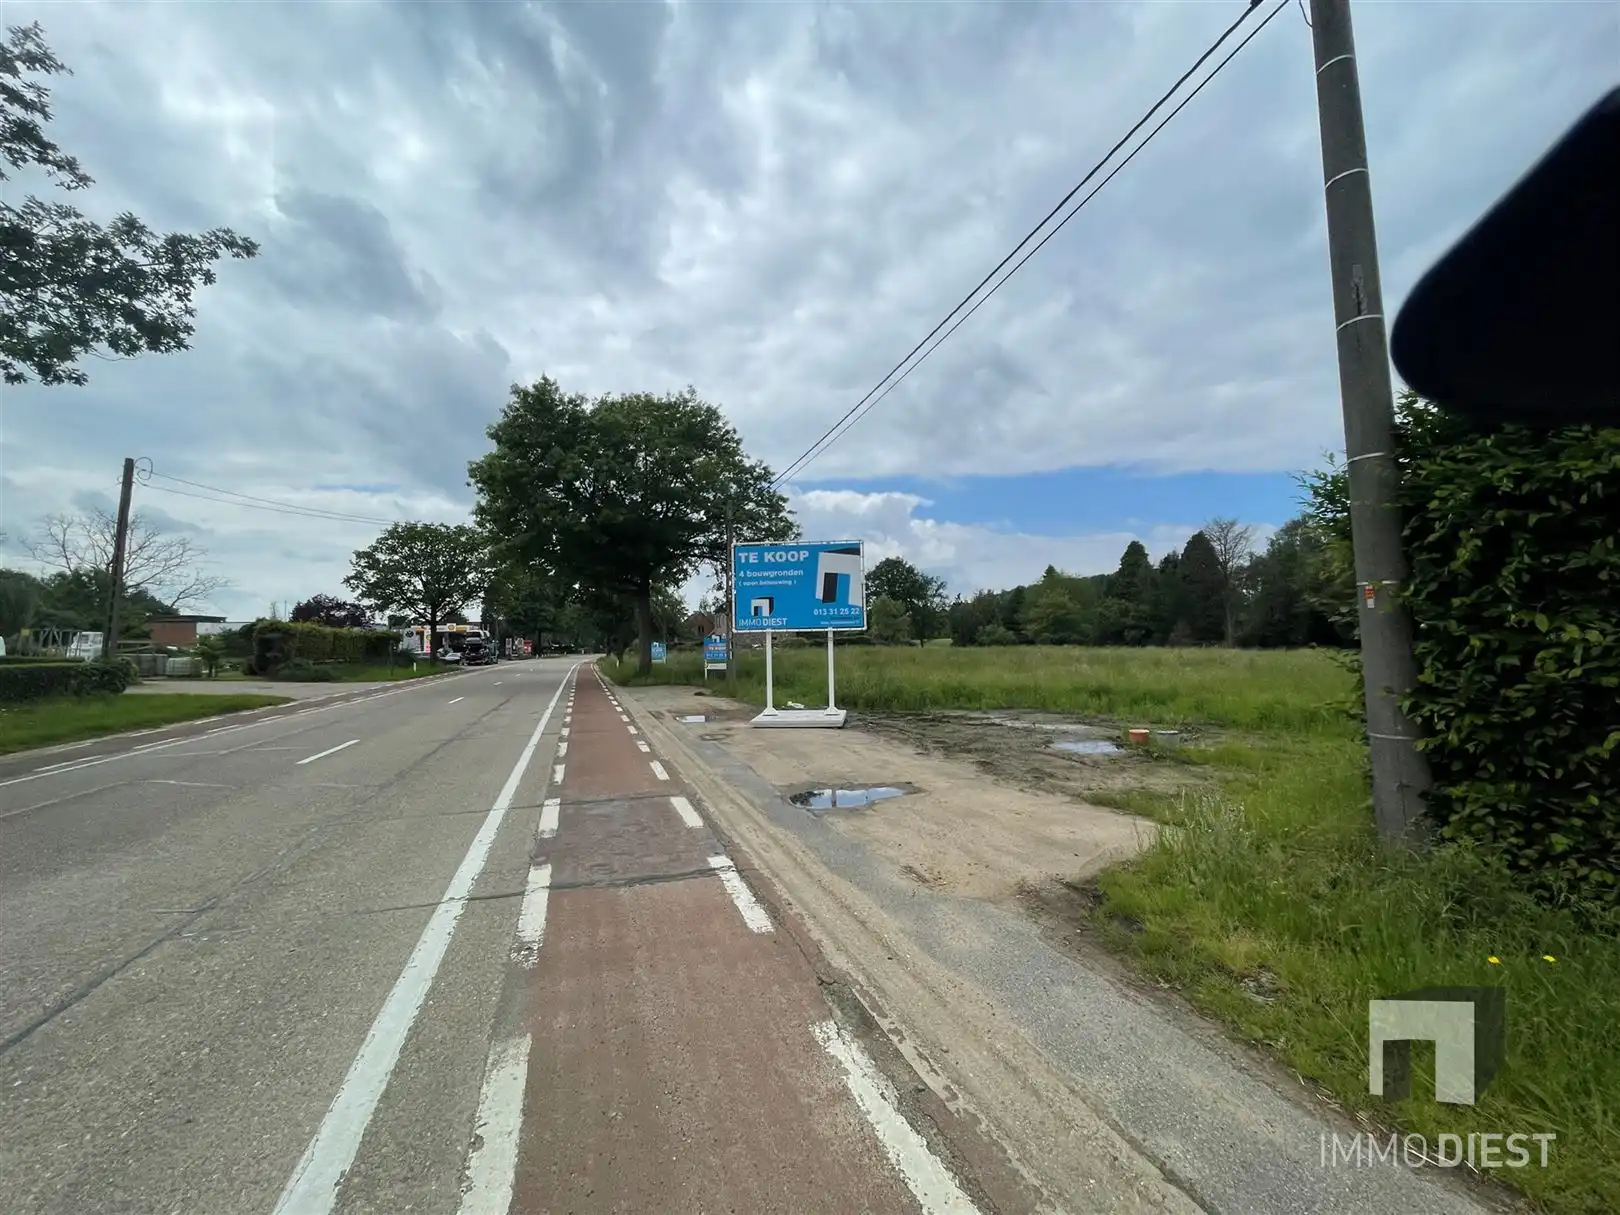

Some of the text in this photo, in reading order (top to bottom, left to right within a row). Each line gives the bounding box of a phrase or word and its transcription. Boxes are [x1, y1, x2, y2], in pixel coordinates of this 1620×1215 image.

[738, 551, 809, 563] TE KOOP
[747, 569, 803, 577] bouwgronden
[739, 618, 788, 626] IMMO DIEST
